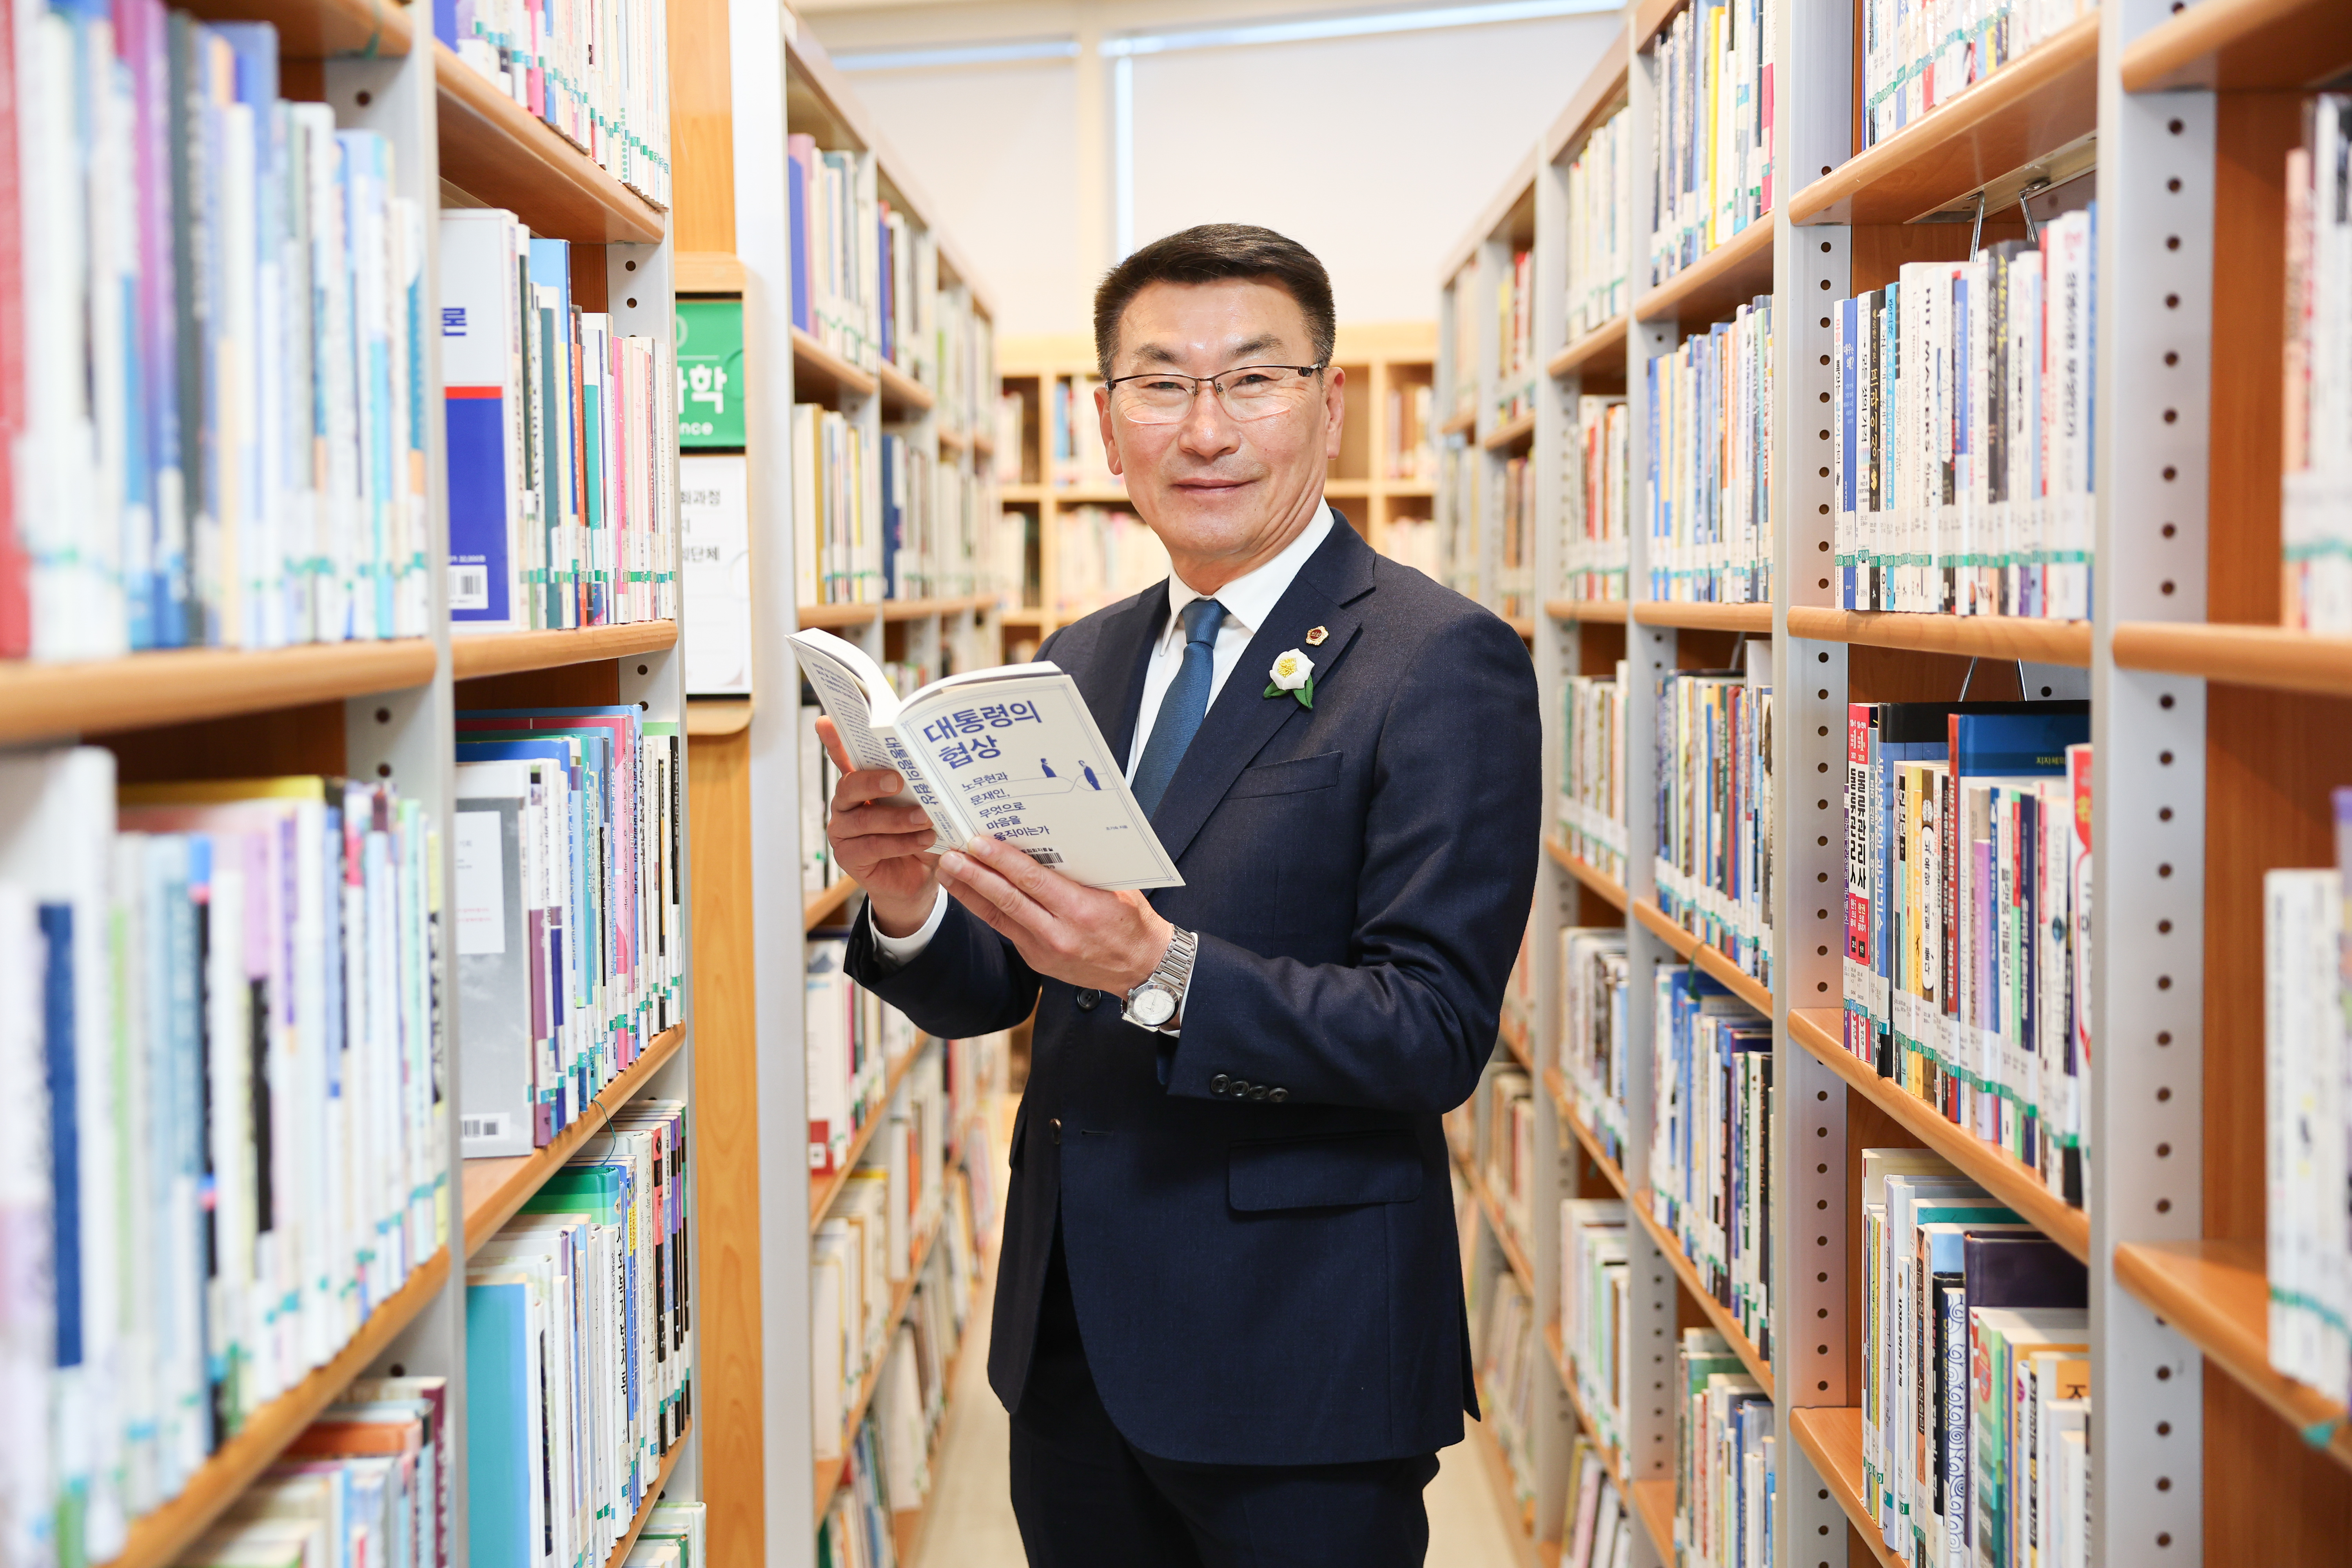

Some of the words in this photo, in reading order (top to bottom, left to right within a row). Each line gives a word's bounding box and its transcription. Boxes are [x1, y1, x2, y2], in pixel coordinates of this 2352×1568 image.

[1862, 415, 1867, 442] 가격
[1858, 550, 1869, 560] 300
[1869, 557, 1878, 567] 300
[923, 700, 1043, 743] 대통령의
[938, 735, 1002, 769] 협상
[884, 737, 924, 781] 대통령의
[913, 783, 939, 806] 협상
[962, 771, 1009, 792] 노무현과
[970, 788, 1011, 806] 문재인,
[979, 802, 1026, 818] 무엇으로
[986, 815, 1022, 830] 마음을
[1857, 770, 1866, 889] 물류관리사
[993, 825, 1051, 842] 움직이는가
[1857, 1005, 1866, 1016] 300
